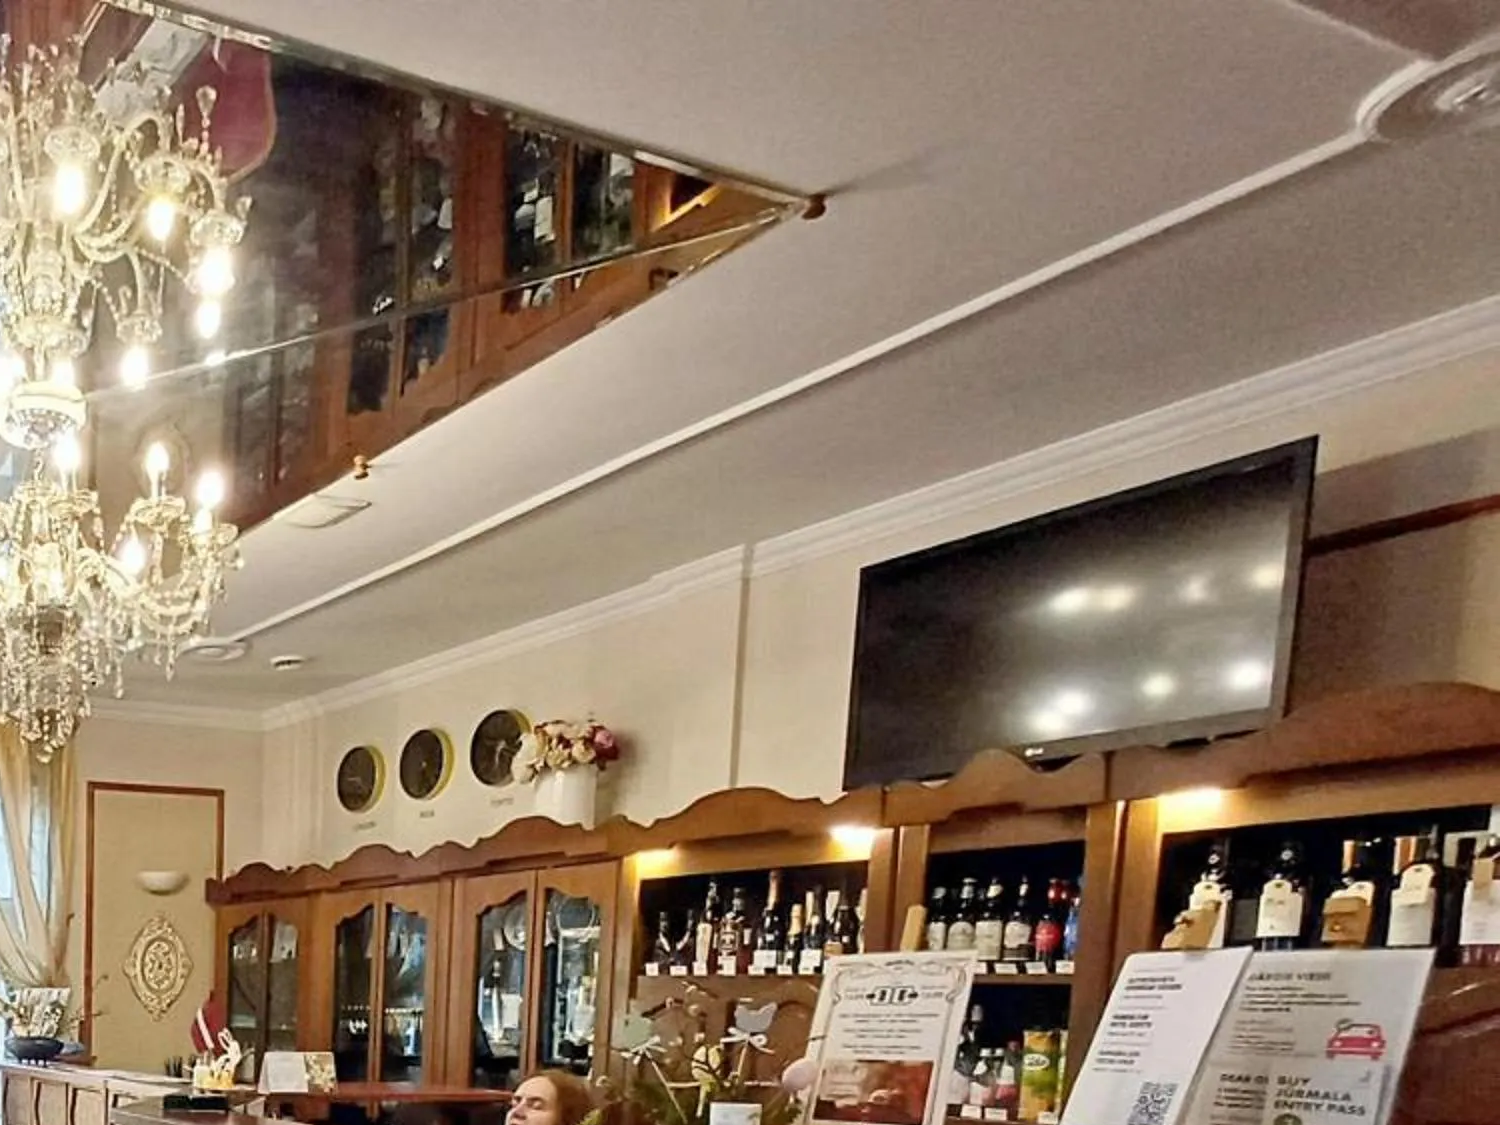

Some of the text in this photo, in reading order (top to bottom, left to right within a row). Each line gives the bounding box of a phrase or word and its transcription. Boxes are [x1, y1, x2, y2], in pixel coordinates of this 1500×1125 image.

[1277, 1075, 1311, 1087] BUY
[1274, 1099, 1366, 1117] ENTRY PASS
